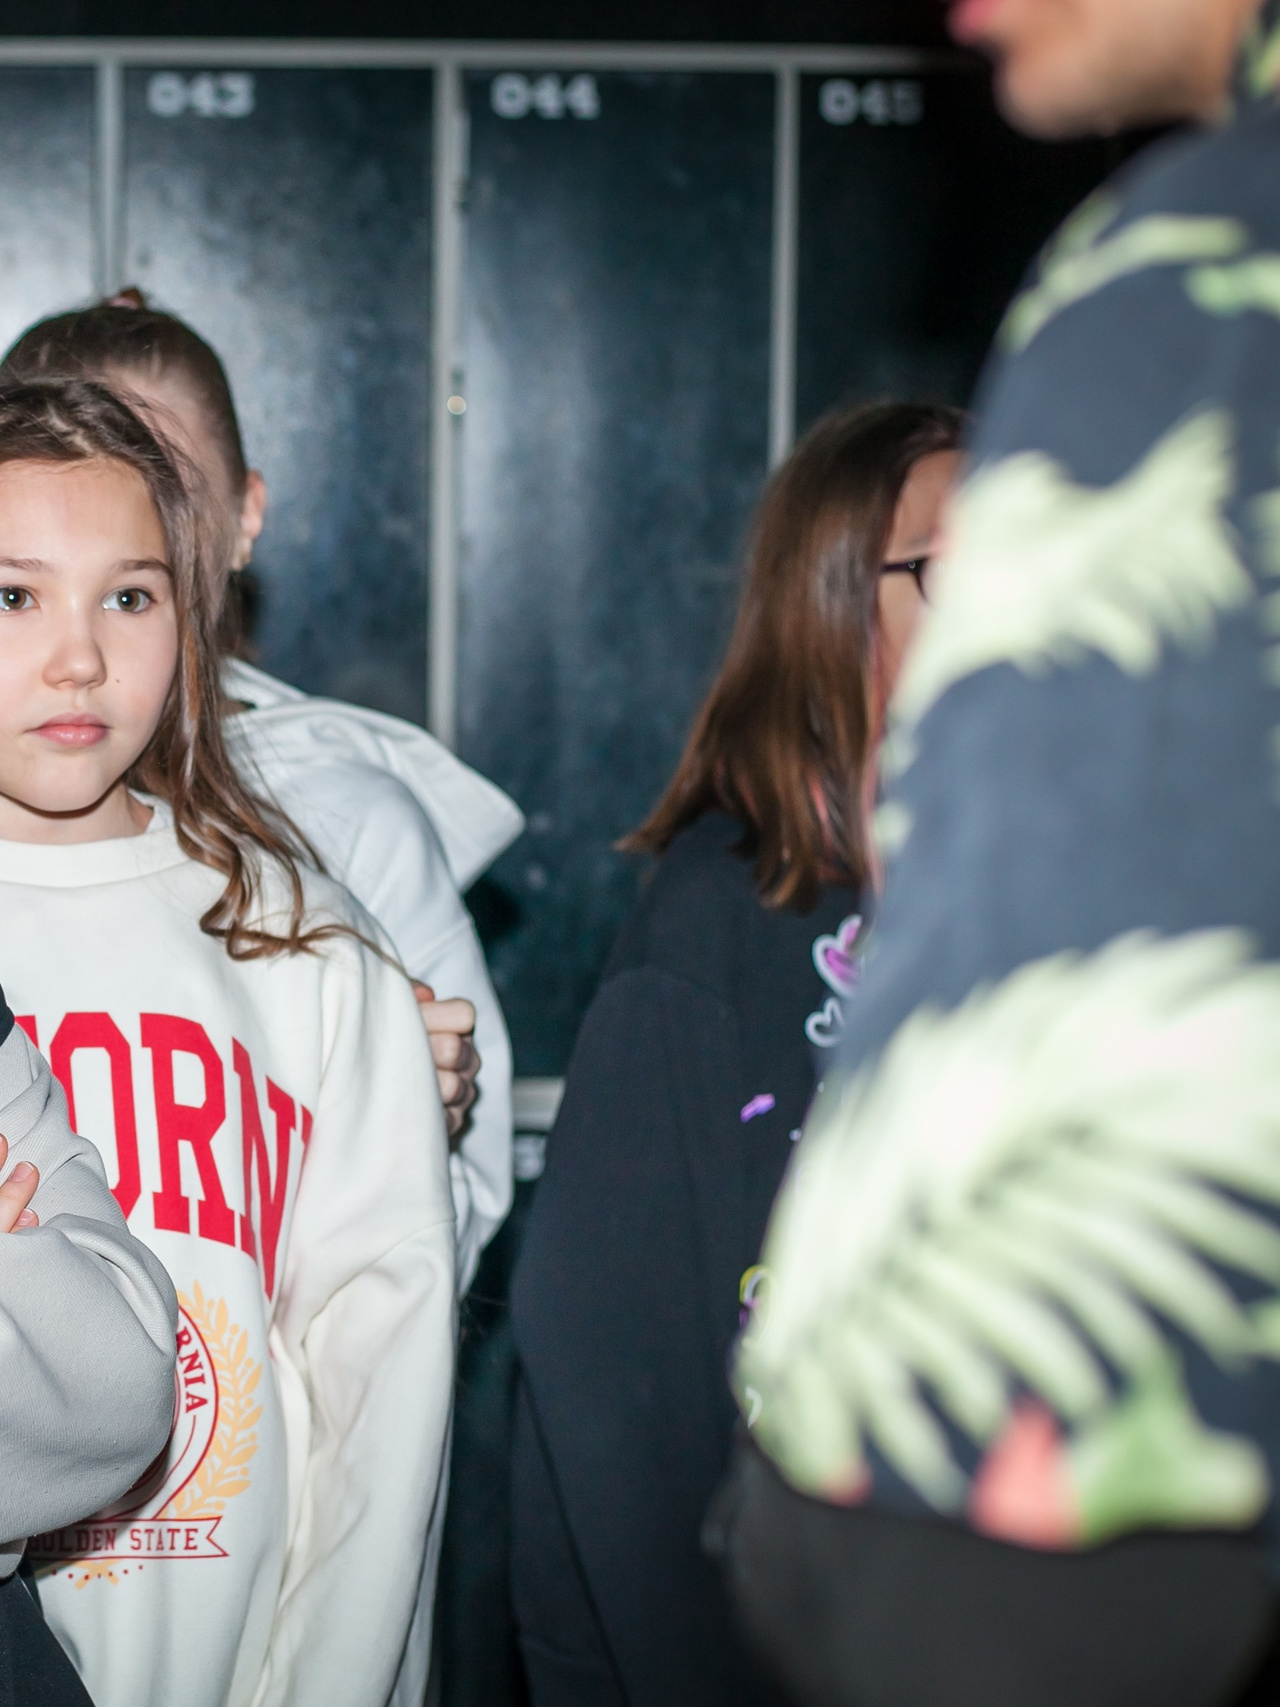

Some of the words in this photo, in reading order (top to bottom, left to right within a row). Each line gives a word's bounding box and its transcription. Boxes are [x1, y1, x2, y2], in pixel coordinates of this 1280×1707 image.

[147, 72, 254, 117] 043
[490, 73, 600, 119] 044
[818, 78, 924, 125] 045
[14, 1012, 313, 1304] ORN
[130, 1528, 199, 1551] STATE
